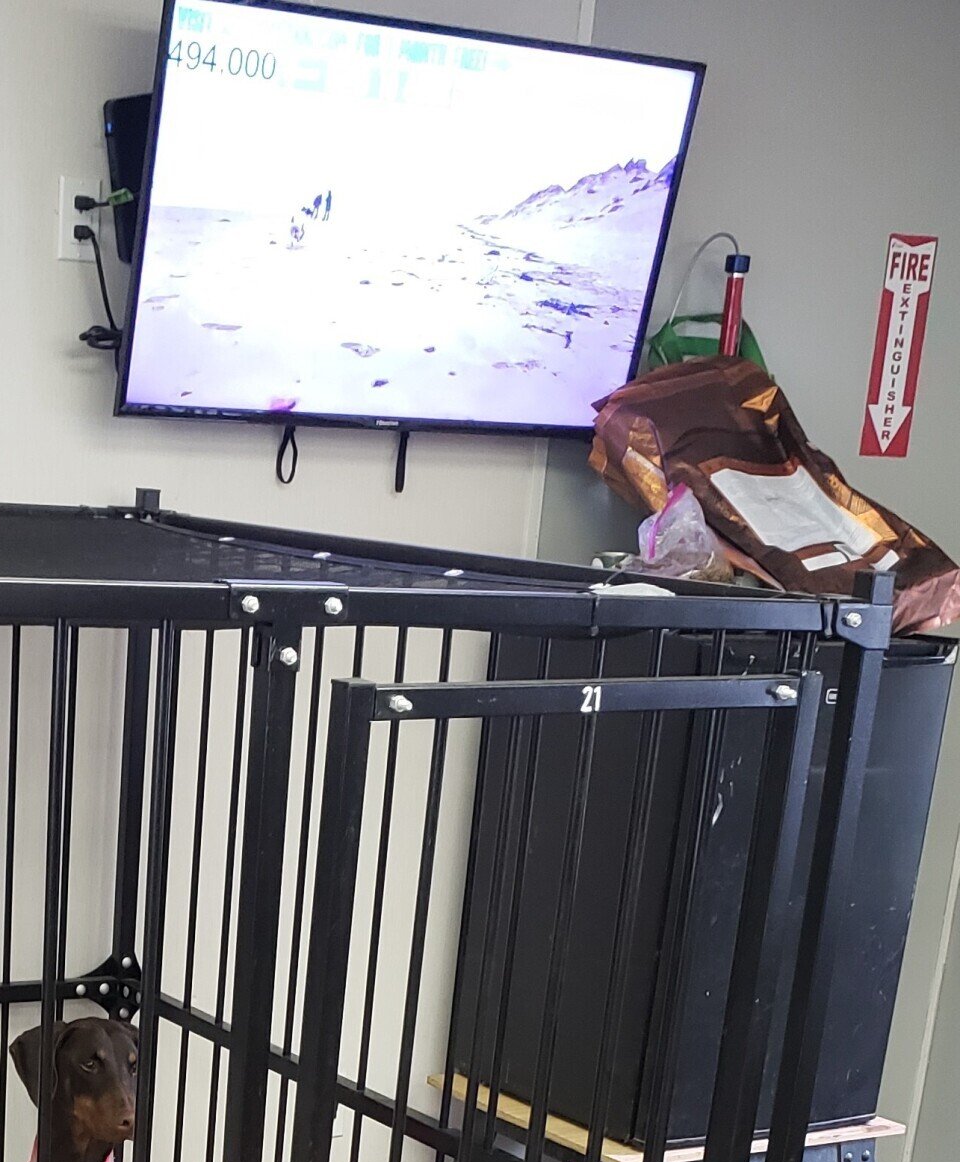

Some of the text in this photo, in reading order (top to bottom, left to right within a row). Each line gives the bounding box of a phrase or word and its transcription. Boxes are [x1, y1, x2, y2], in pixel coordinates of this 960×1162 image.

[889, 251, 931, 282] FIRE
[881, 283, 912, 441] EXTINGUISHER
[580, 685, 602, 713] 21
